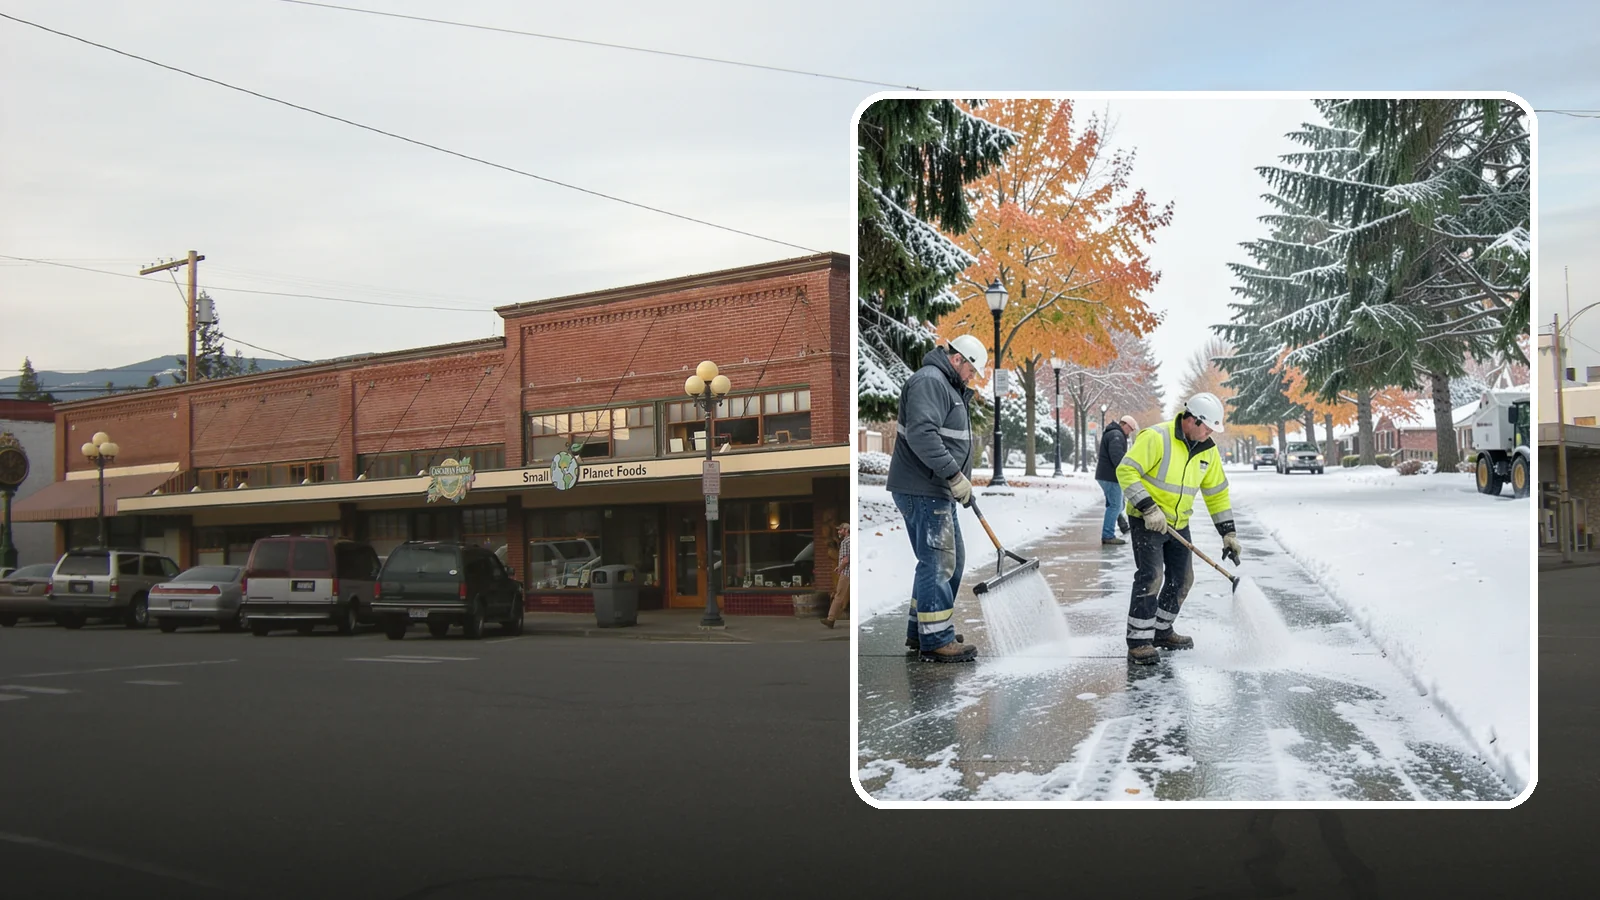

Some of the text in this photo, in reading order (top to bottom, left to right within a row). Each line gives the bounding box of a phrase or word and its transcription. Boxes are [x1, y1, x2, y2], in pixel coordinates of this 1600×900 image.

[523, 464, 647, 483] Small Planet Foods
